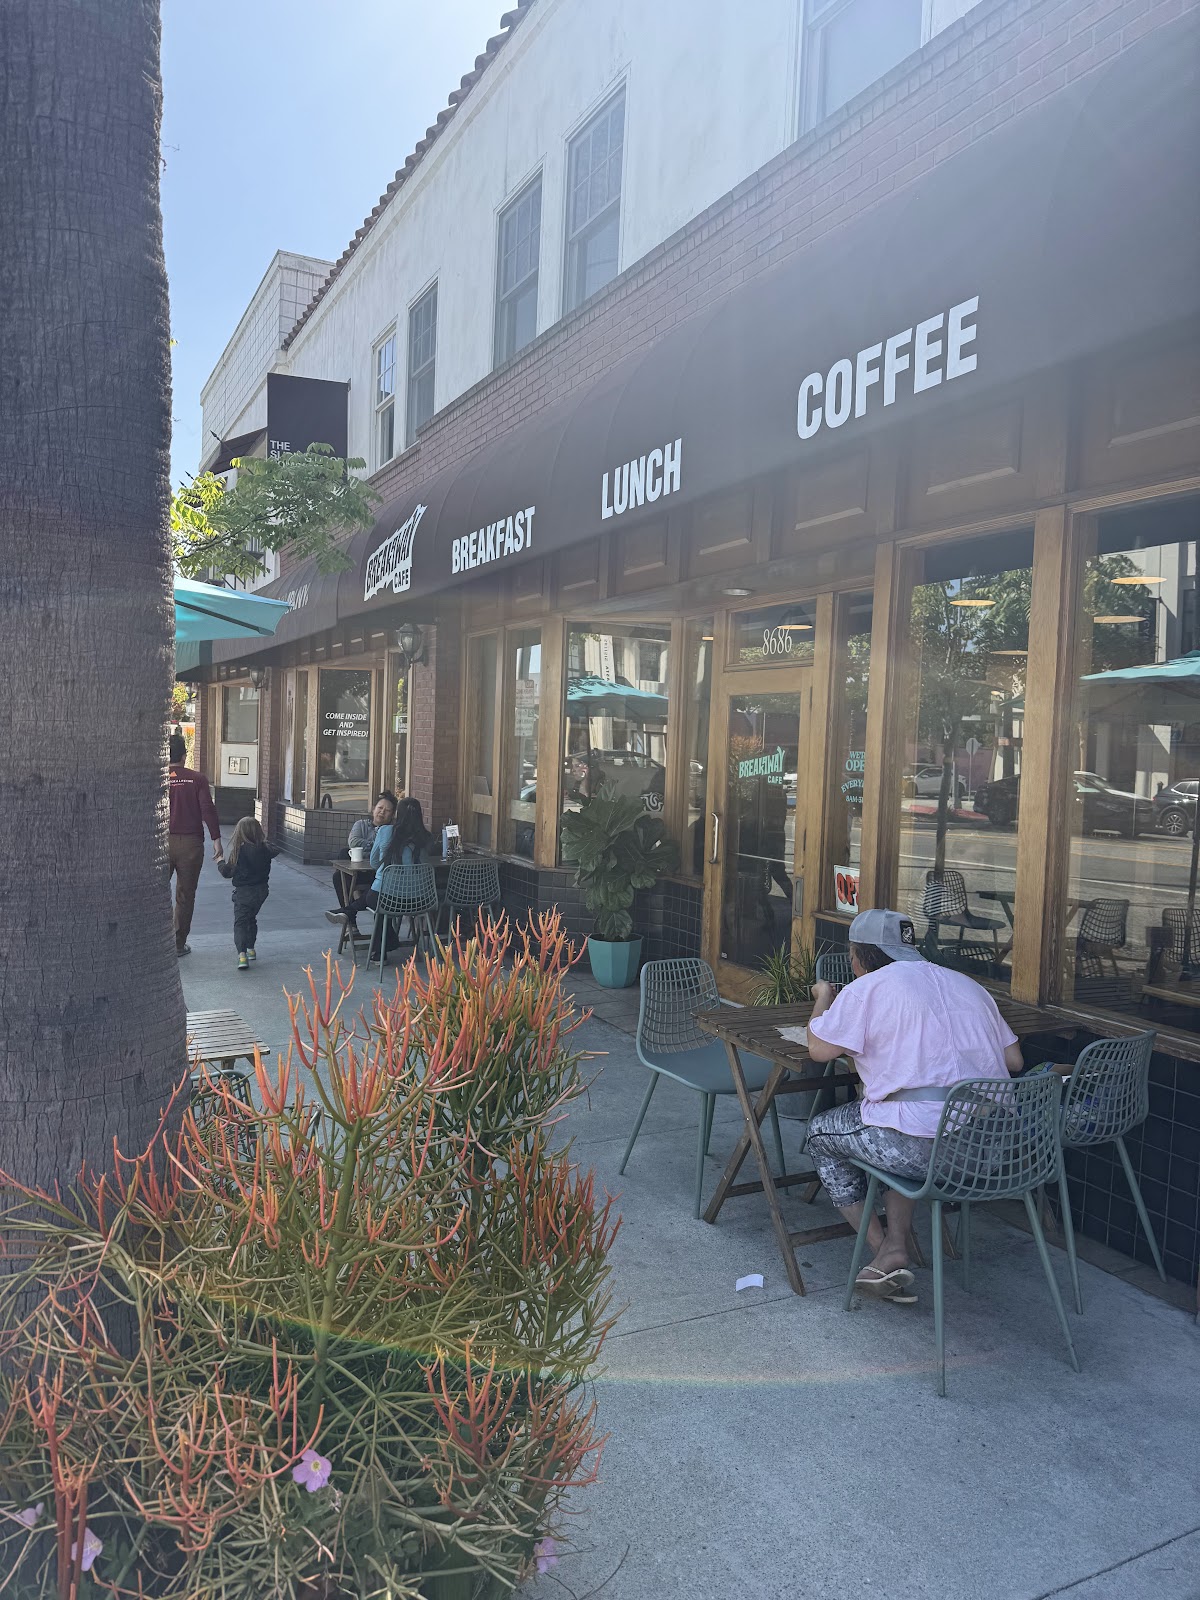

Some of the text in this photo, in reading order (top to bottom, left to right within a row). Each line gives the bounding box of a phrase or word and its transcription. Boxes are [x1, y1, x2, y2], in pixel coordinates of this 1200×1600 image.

[797, 296, 980, 440] COFFEE
[270, 440, 291, 451] THE
[601, 438, 682, 520] LUNCH
[452, 506, 536, 574] BREAKFAST
[394, 569, 409, 589] CAFE
[763, 626, 792, 656] 8686
[325, 712, 367, 721] COME INSIDE
[338, 721, 354, 729] AND
[336, 729, 369, 738] INSPIRED!
[850, 751, 865, 759] WE'R
[739, 746, 786, 779] BREAKAWAY
[845, 760, 865, 772] OPE
[767, 776, 783, 784] CAFE
[841, 780, 864, 793] EVERY
[836, 873, 860, 906] OP
